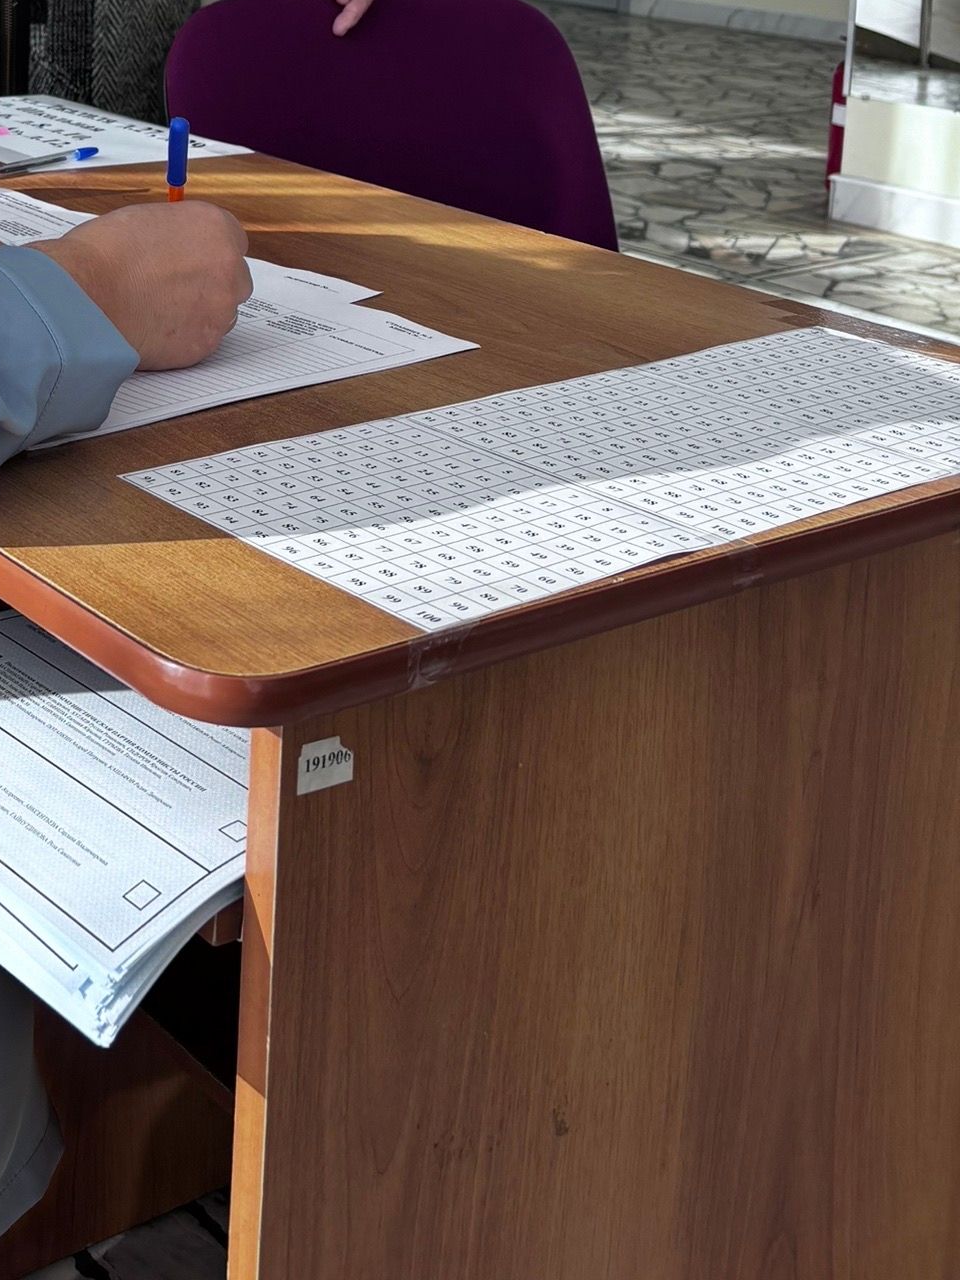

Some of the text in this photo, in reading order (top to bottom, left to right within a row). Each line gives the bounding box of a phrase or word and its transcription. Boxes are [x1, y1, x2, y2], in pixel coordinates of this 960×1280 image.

[139, 475, 443, 623] 91 92 93 94 95 96 97 98 99 100
[168, 468, 470, 612] 81 82 83 84 85 86 87 88 89 90
[197, 462, 500, 602] 71 72 73 74 75 76 77 78 79 80
[224, 456, 529, 594] 61 62 63 64 65 66 67 68 69 70
[397, 515, 415, 524] 56
[429, 529, 451, 538] 57
[463, 544, 485, 554] 58
[499, 559, 521, 569] 59
[536, 575, 557, 585] 60
[426, 508, 443, 517] 46
[459, 522, 479, 530] 47
[493, 537, 513, 545] 48
[528, 551, 548, 560] 49
[563, 566, 585, 576] 50
[451, 501, 470, 510] 36
[484, 514, 506, 523] 37
[518, 529, 540, 538] 38
[554, 543, 576, 552] 39
[592, 558, 612, 567] 40
[478, 494, 496, 502] 26
[511, 507, 532, 515] 27
[545, 521, 566, 529] 28
[580, 534, 602, 543] 29
[617, 548, 639, 557] 30
[505, 487, 522, 495] 16
[538, 499, 558, 508] 17
[572, 513, 592, 522] 18
[608, 526, 628, 535] 19
[644, 539, 665, 548] 20
[670, 533, 691, 542] 10
[305, 750, 351, 773] 191906
